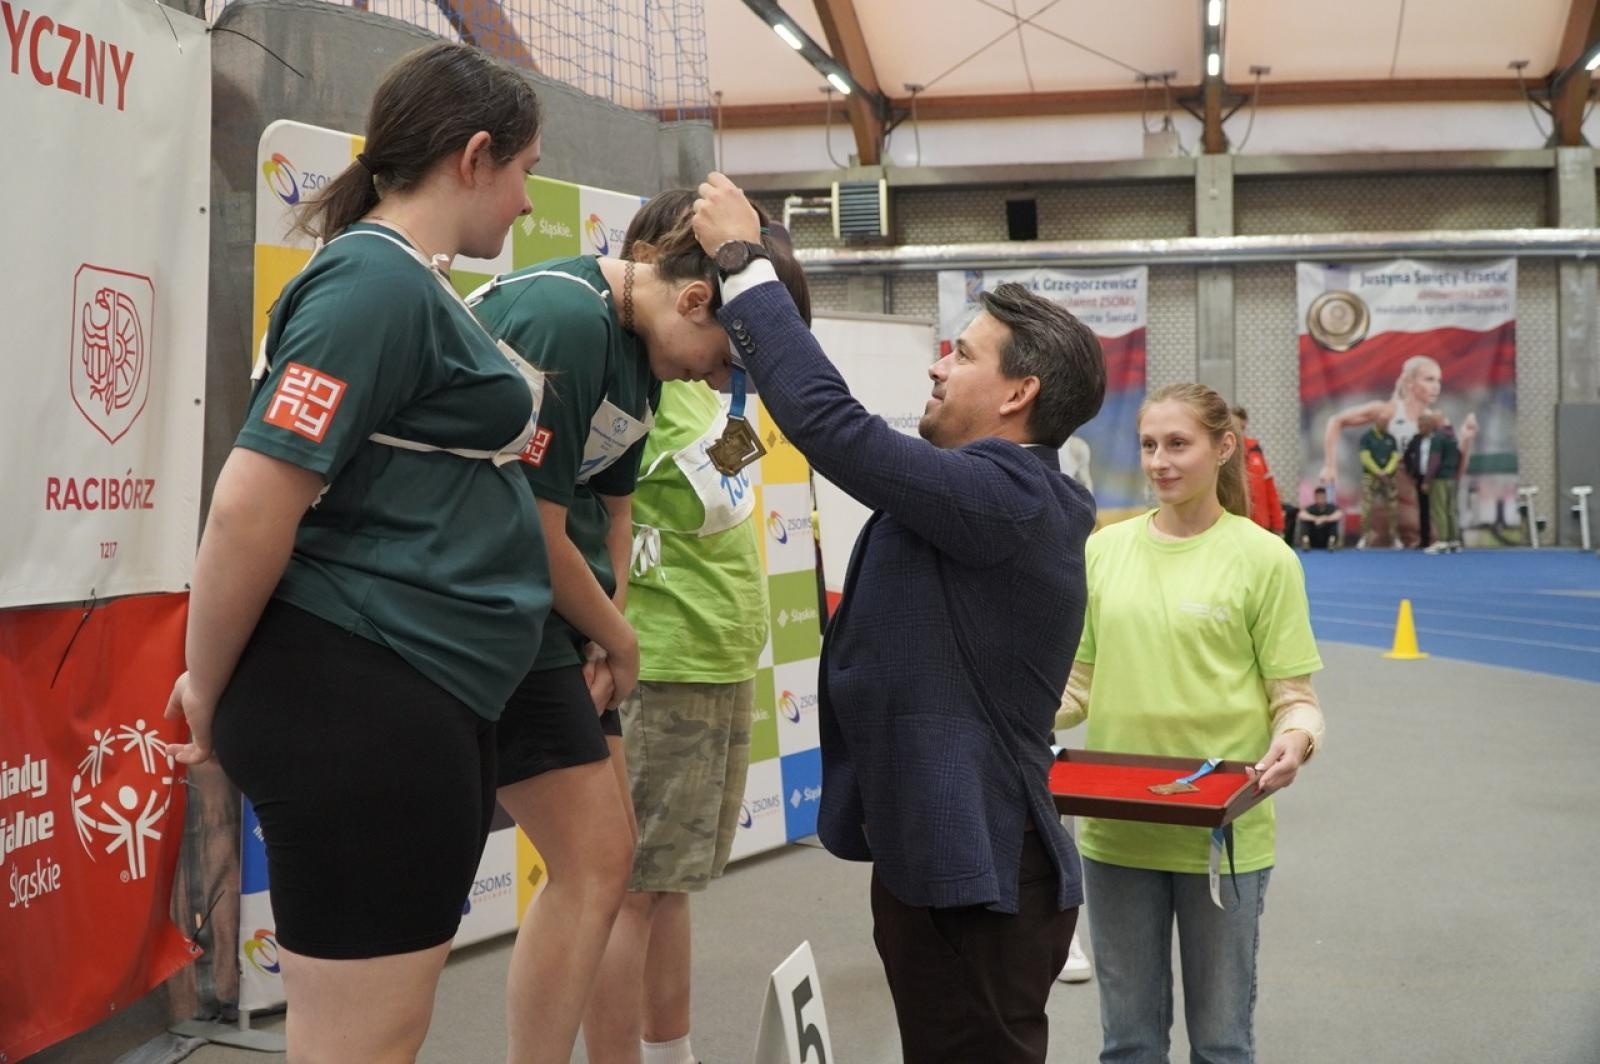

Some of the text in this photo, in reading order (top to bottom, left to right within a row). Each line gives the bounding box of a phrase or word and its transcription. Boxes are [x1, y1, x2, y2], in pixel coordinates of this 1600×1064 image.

[302, 171, 332, 190] ZSO
[46, 467, 155, 511] RACIBÓRZ
[100, 542, 118, 559] 1217
[0, 754, 47, 799] iady
[9, 857, 61, 908] Śląskie
[473, 872, 512, 896] ZSOMS
[791, 975, 828, 1064] 5
